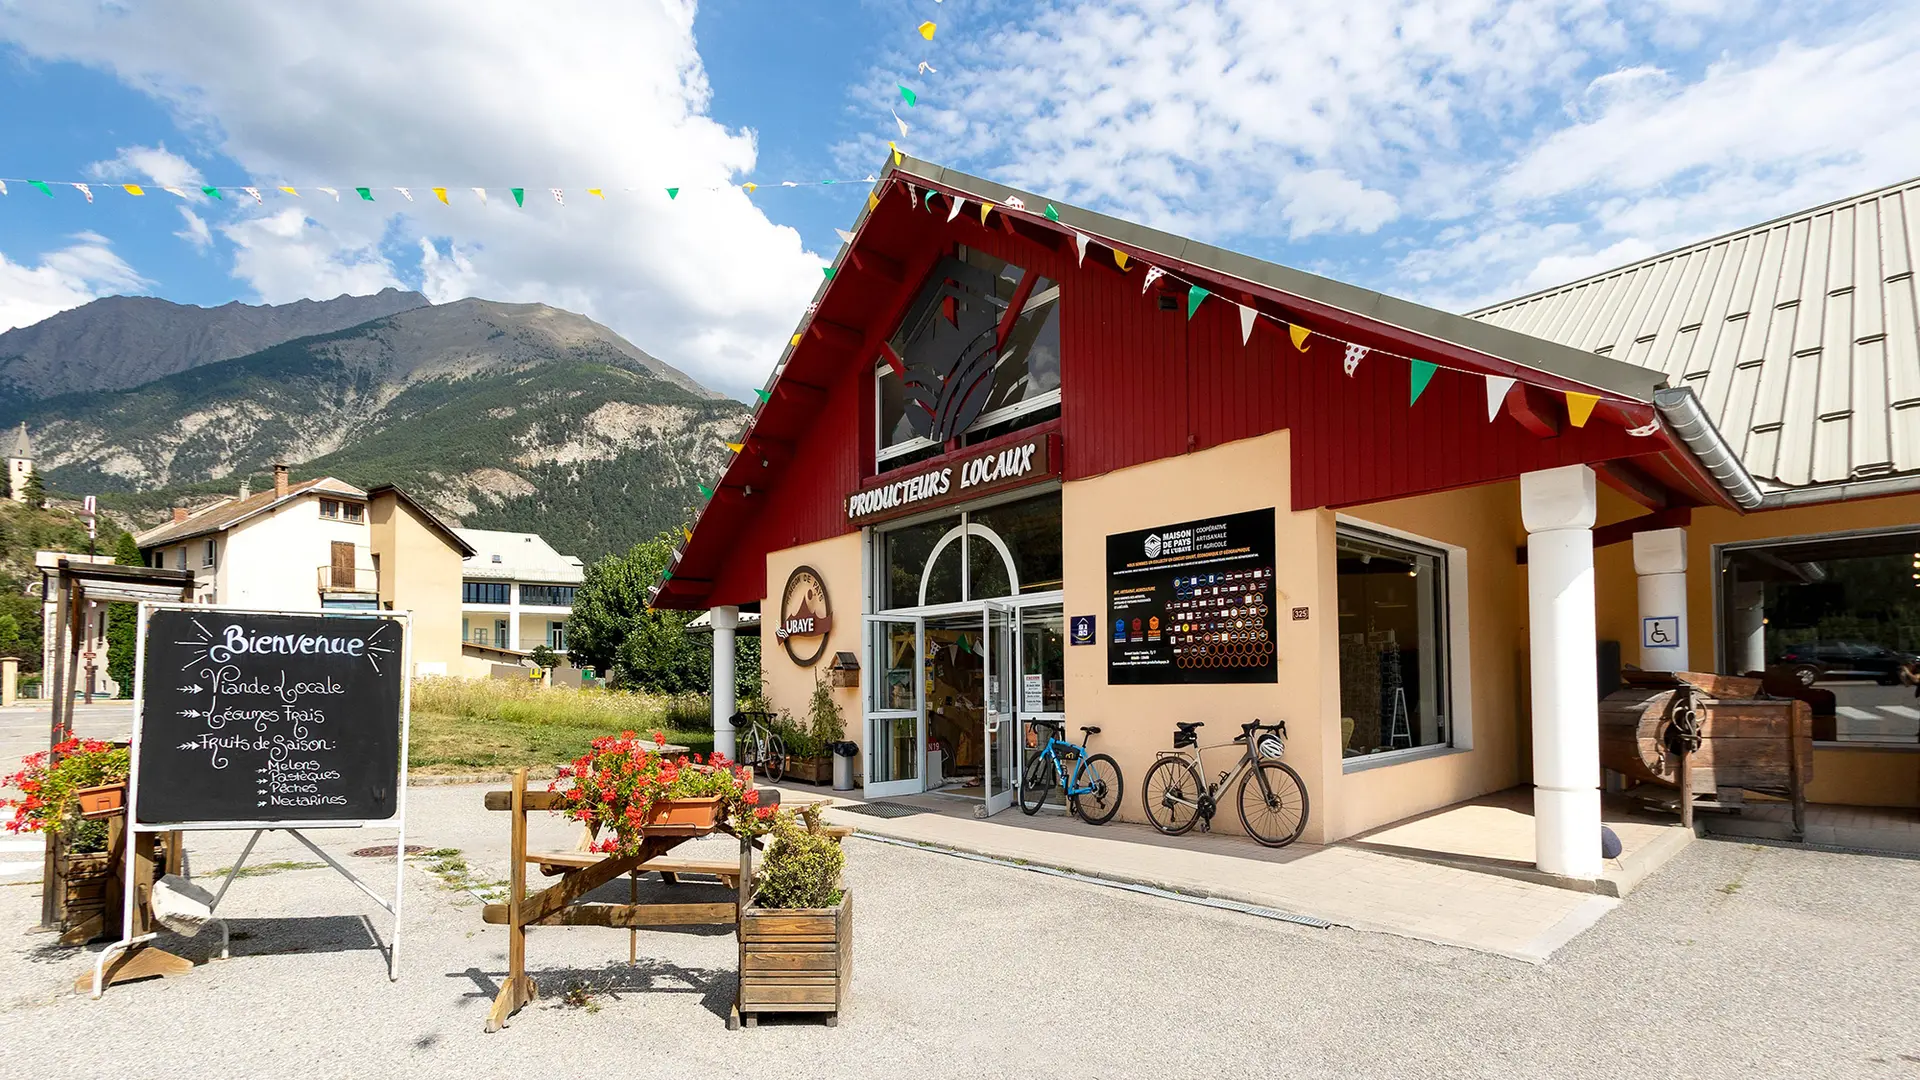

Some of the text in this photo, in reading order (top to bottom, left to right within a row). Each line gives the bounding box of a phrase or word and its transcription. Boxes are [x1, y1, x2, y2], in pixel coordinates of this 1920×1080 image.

[849, 443, 1036, 518] PRODUCTEURS LOCAUX
[1162, 529, 1192, 541] MAISON
[1195, 532, 1227, 542] ARTISANALE
[1162, 538, 1192, 549] DE PAYS
[1171, 545, 1192, 554] L'UBAYE
[1203, 541, 1227, 550] AGRICOLE
[786, 618, 814, 633] UBAYE
[210, 624, 365, 663] Bienvenue
[200, 665, 345, 703] Viande Locale
[252, 736, 270, 750] de
[267, 760, 321, 772] Melons
[268, 770, 341, 783] Pastèques
[268, 781, 318, 794] Pêches
